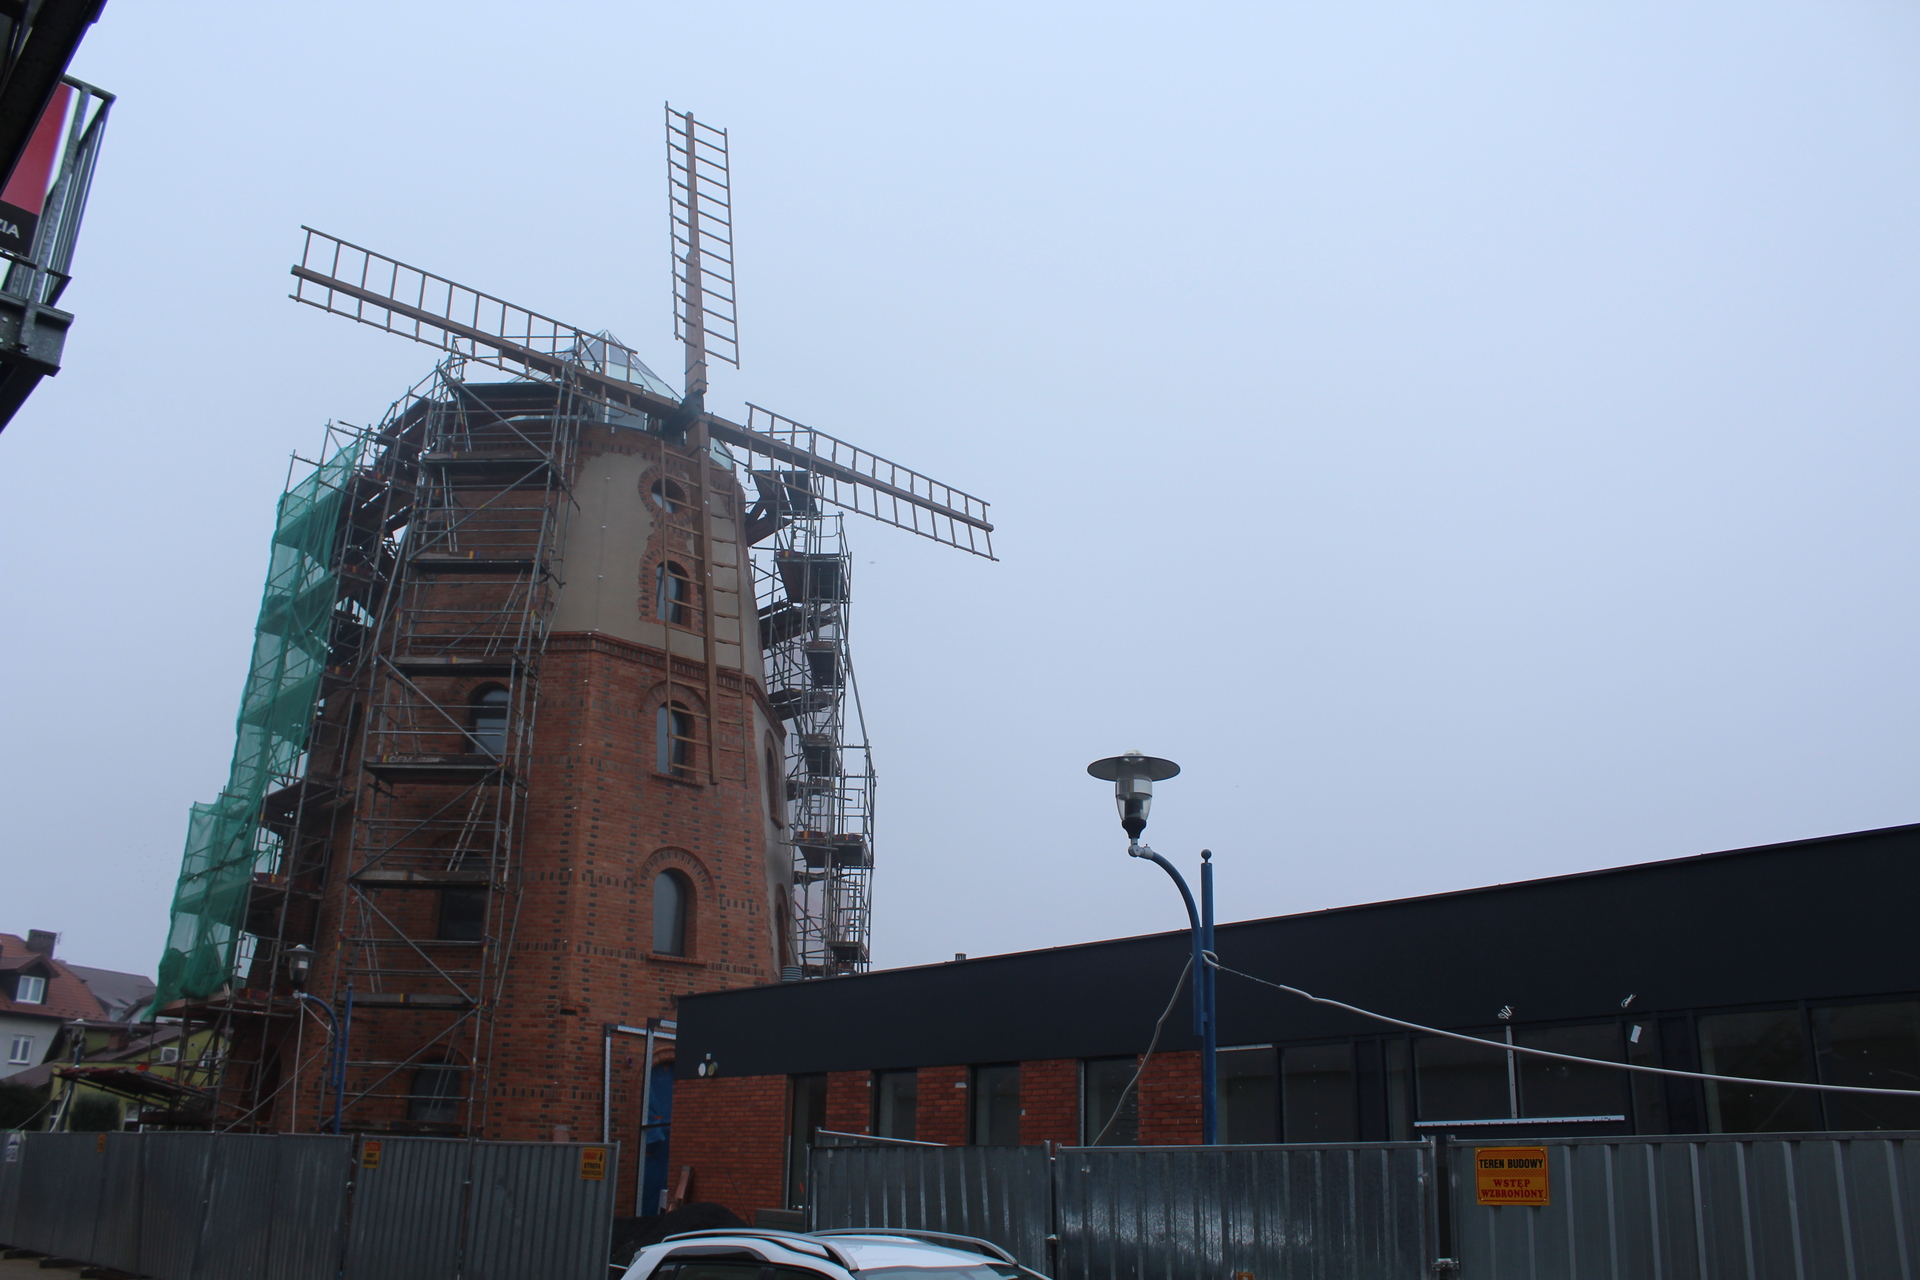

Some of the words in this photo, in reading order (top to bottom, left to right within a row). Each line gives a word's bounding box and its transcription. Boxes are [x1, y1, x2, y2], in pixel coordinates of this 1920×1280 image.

[1479, 1159, 1505, 1169] TEREN
[1507, 1158, 1544, 1169] BUDOWY
[1493, 1178, 1531, 1189] WSTĘP
[1481, 1189, 1544, 1198] WZBRONIONY
